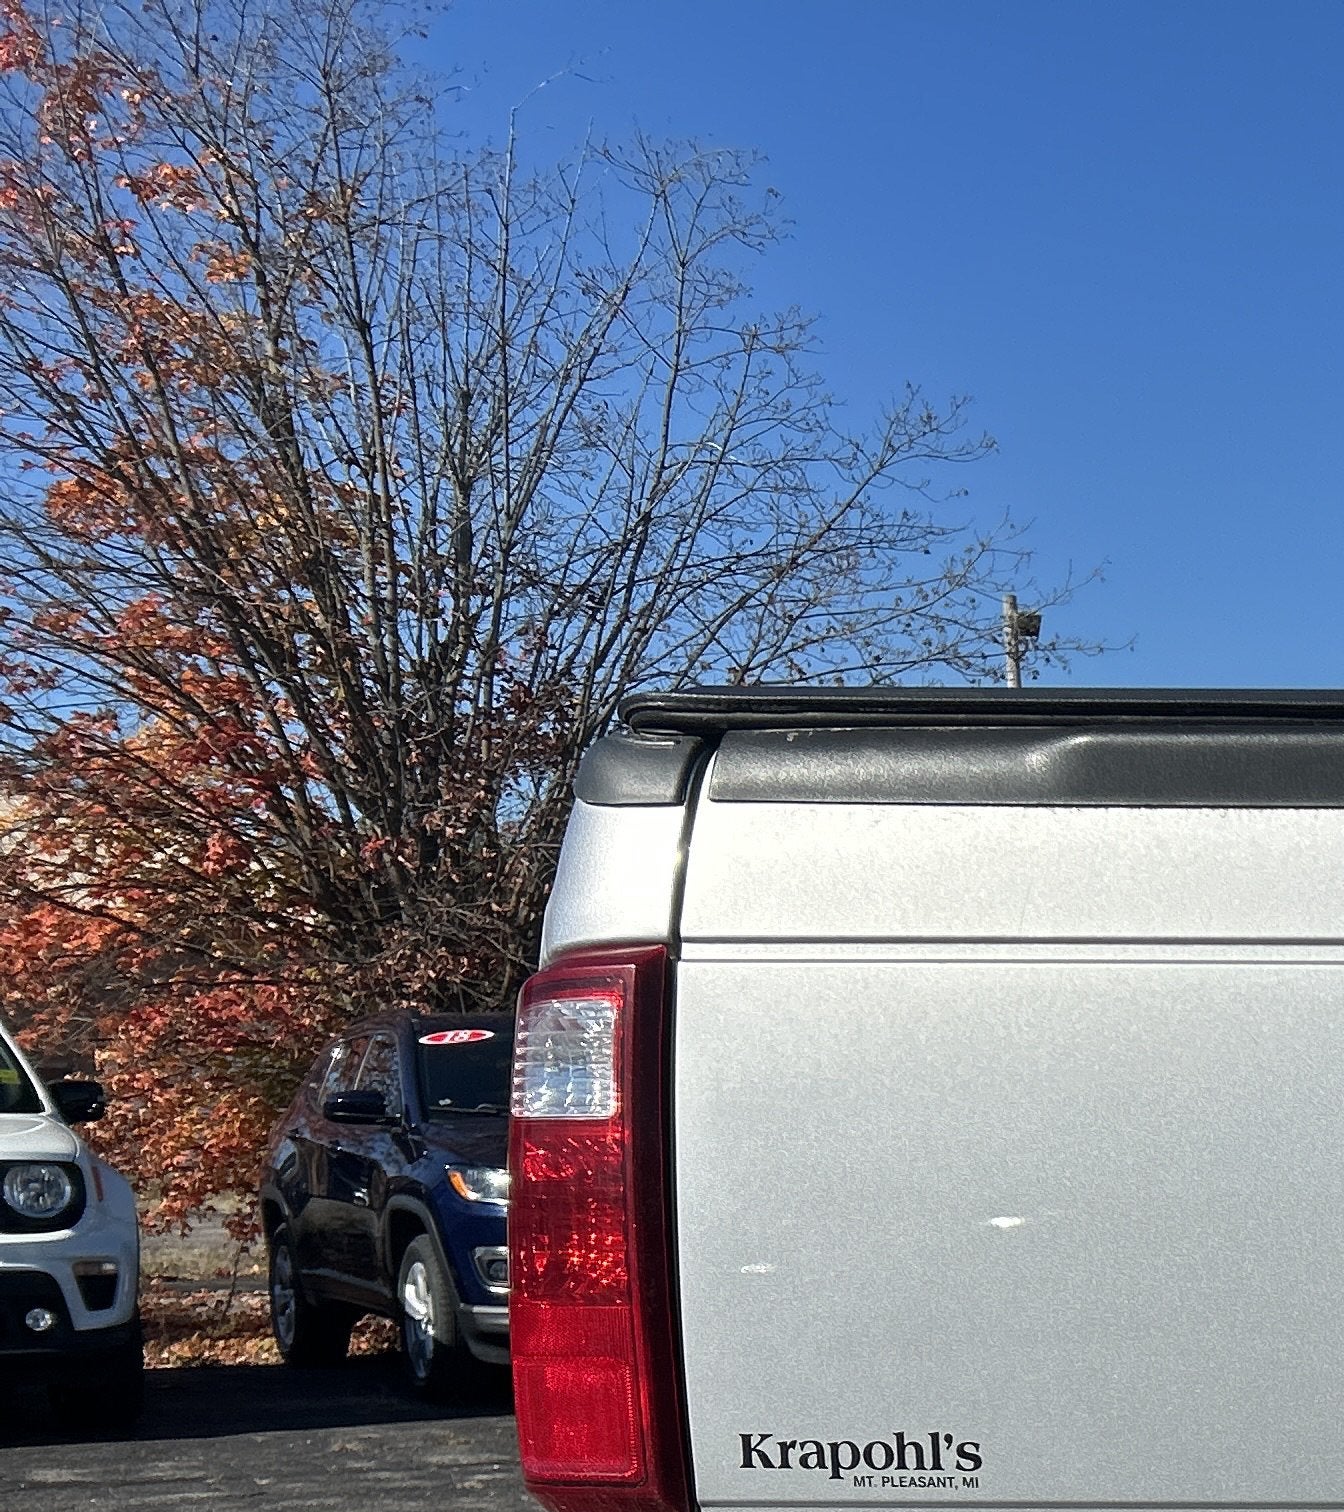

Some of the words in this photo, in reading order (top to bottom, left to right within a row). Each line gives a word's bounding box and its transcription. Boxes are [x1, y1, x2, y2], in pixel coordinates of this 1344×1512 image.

[738, 1431, 984, 1480] Krapohl's
[853, 1475, 878, 1488] MT.
[881, 1476, 958, 1490] PLEASANT,
[962, 1477, 979, 1489] MI
